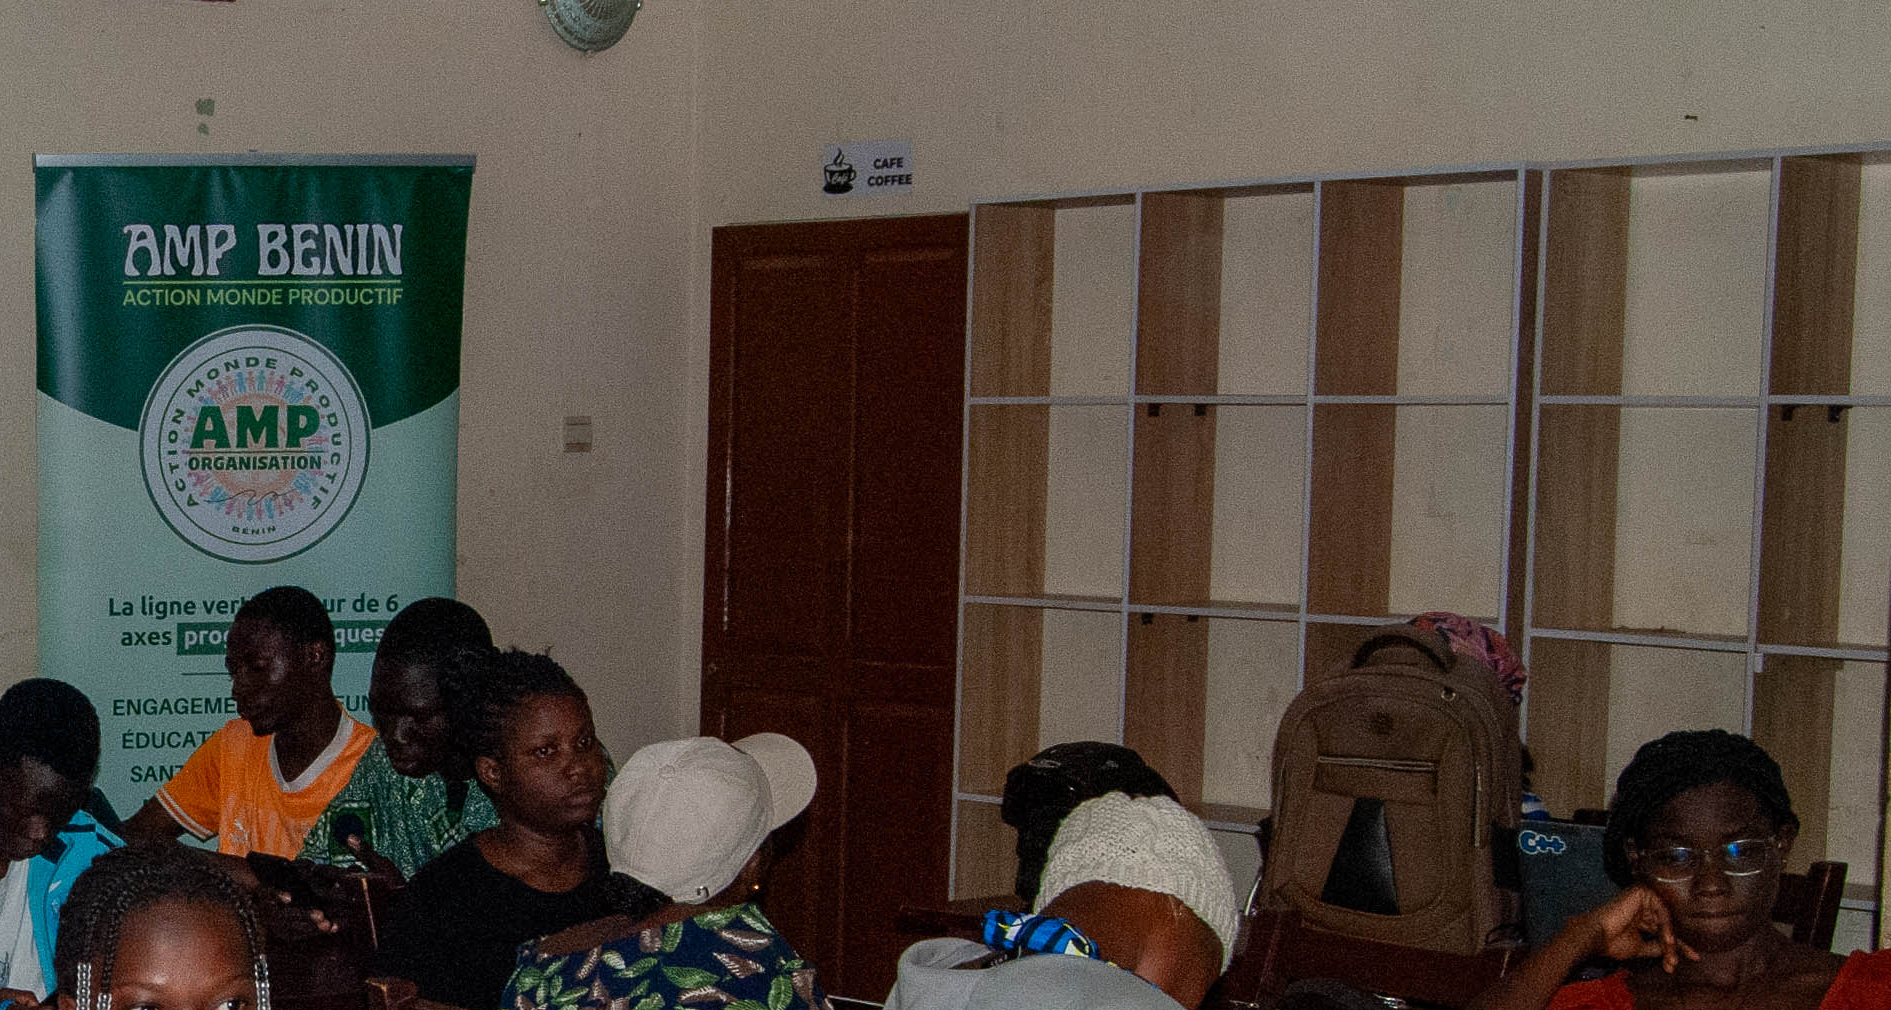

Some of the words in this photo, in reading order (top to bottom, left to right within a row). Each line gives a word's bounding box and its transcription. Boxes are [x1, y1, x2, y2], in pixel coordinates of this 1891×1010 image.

[873, 157, 904, 169] CAFE
[867, 174, 912, 186] COFFEE
[123, 223, 237, 276] AMP
[257, 223, 403, 276] BENIN
[123, 289, 201, 306] ACTION
[208, 288, 282, 305] MONDE
[289, 288, 403, 305] PRODUCTIF
[167, 408, 199, 507] ACTION
[187, 357, 278, 399] MONDE
[290, 366, 342, 510] PRODUCTIF
[189, 405, 321, 449] AMP
[188, 455, 322, 471] ORGANISATION
[108, 598, 134, 616] La
[141, 596, 196, 620] ligne
[352, 593, 381, 613] de
[386, 594, 399, 612] 6
[121, 629, 172, 647] axes
[112, 698, 237, 717] ENGAGEME
[122, 729, 215, 750] ÉDUCAT
[1519, 830, 1566, 854] C++
